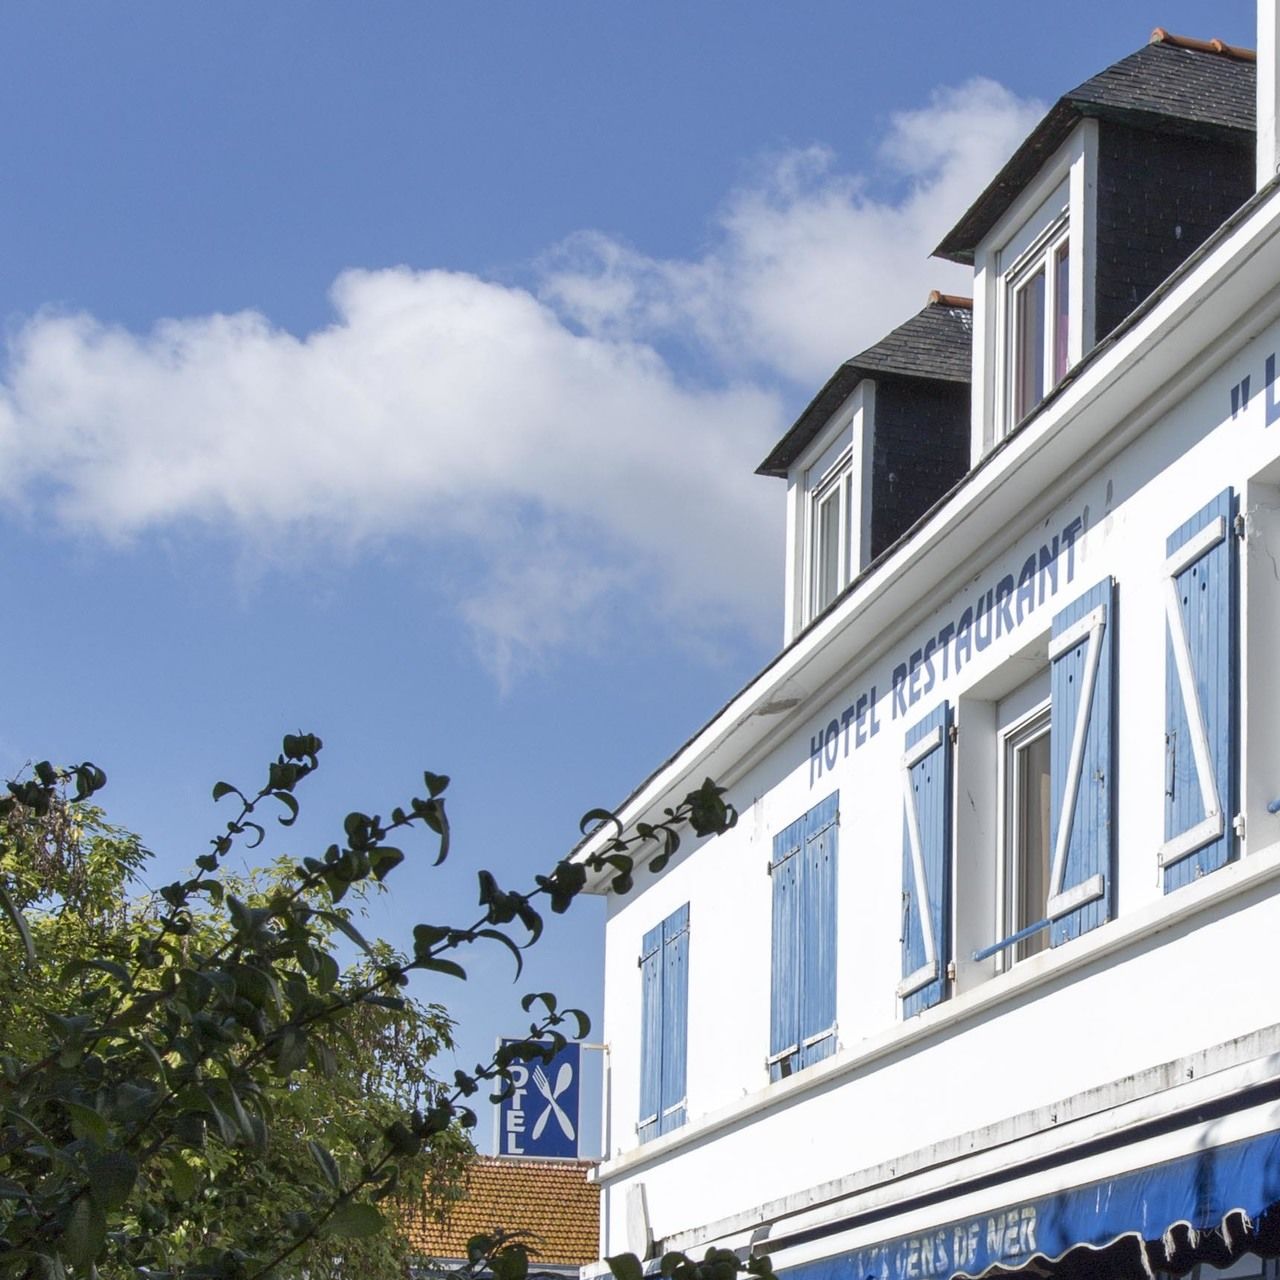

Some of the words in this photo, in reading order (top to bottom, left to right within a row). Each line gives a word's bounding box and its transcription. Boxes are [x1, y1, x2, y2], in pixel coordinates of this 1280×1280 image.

[809, 686, 881, 790] HOTEL
[891, 516, 1083, 721] RESTAURANT
[506, 1042, 529, 1154] OTEL
